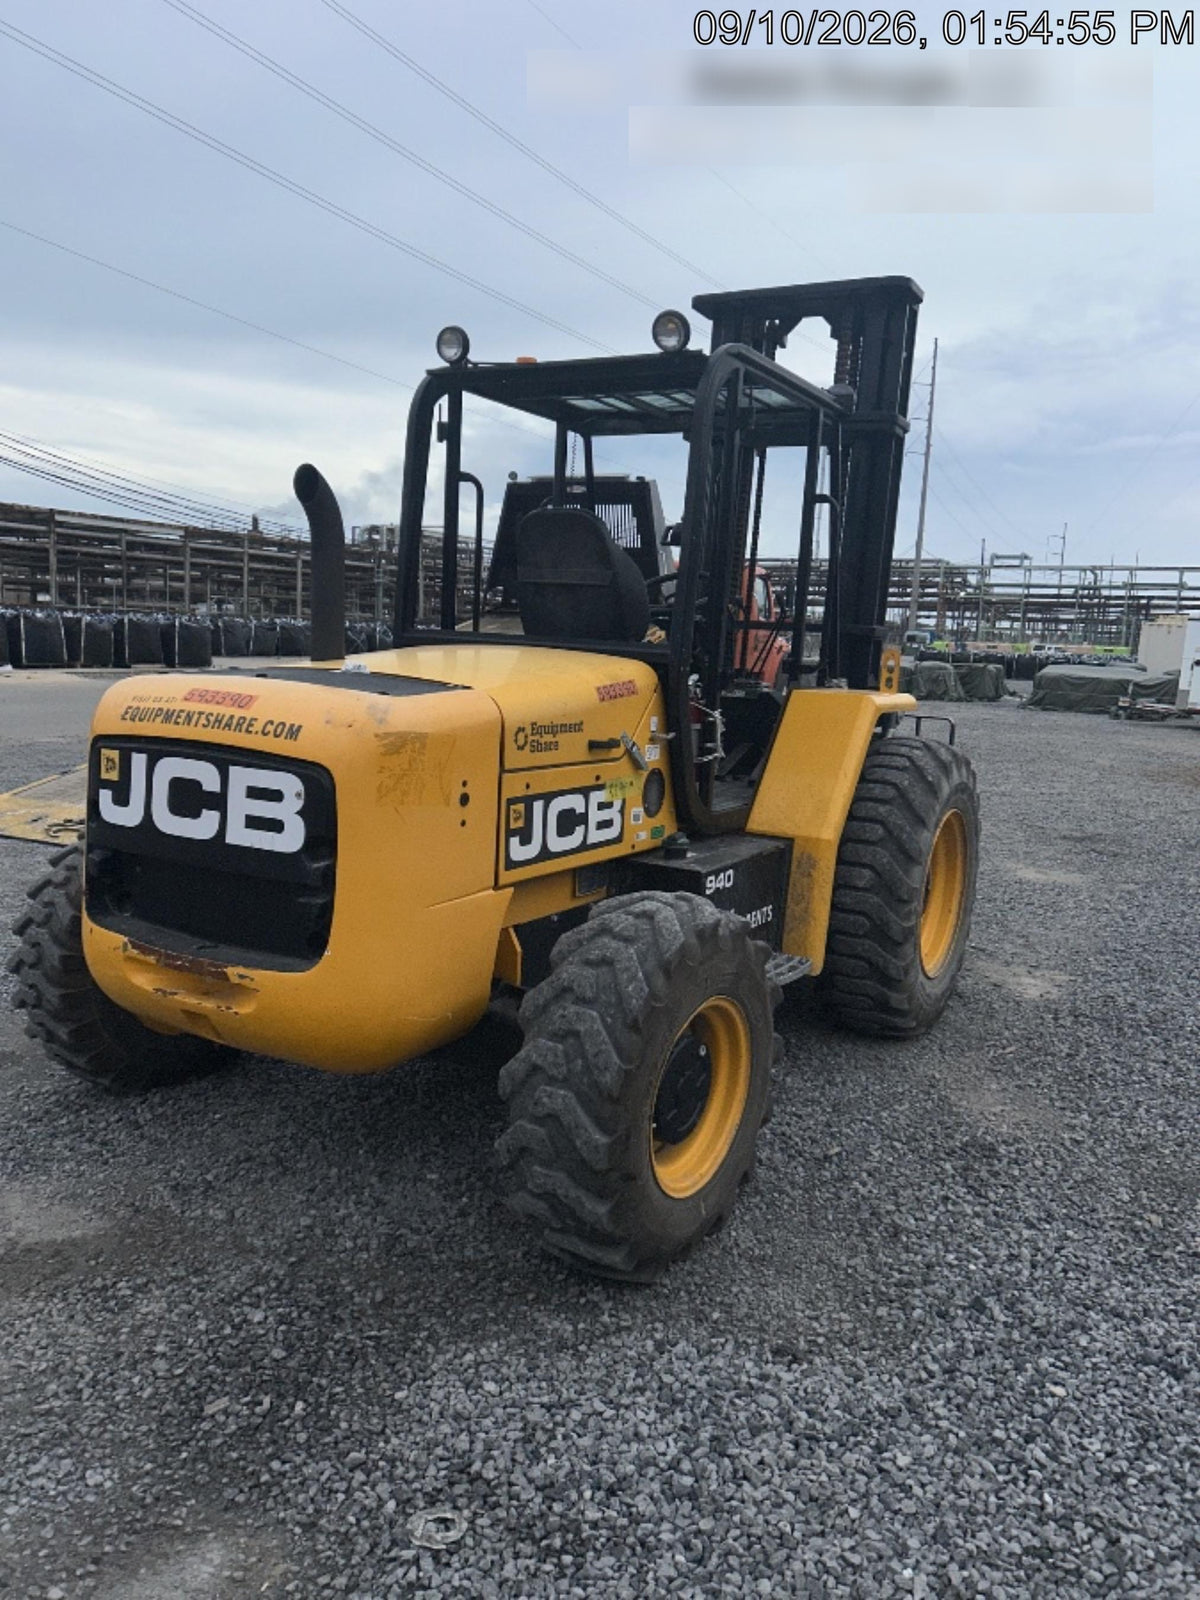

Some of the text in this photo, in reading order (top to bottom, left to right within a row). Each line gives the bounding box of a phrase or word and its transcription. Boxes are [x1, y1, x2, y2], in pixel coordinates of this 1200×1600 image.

[121, 705, 303, 741] EQUIPMENTSHARE.COM
[530, 720, 583, 739] Equipment
[529, 739, 559, 753] Share
[99, 752, 306, 854] JCB
[509, 789, 623, 861] JCB
[705, 868, 734, 895] 940
